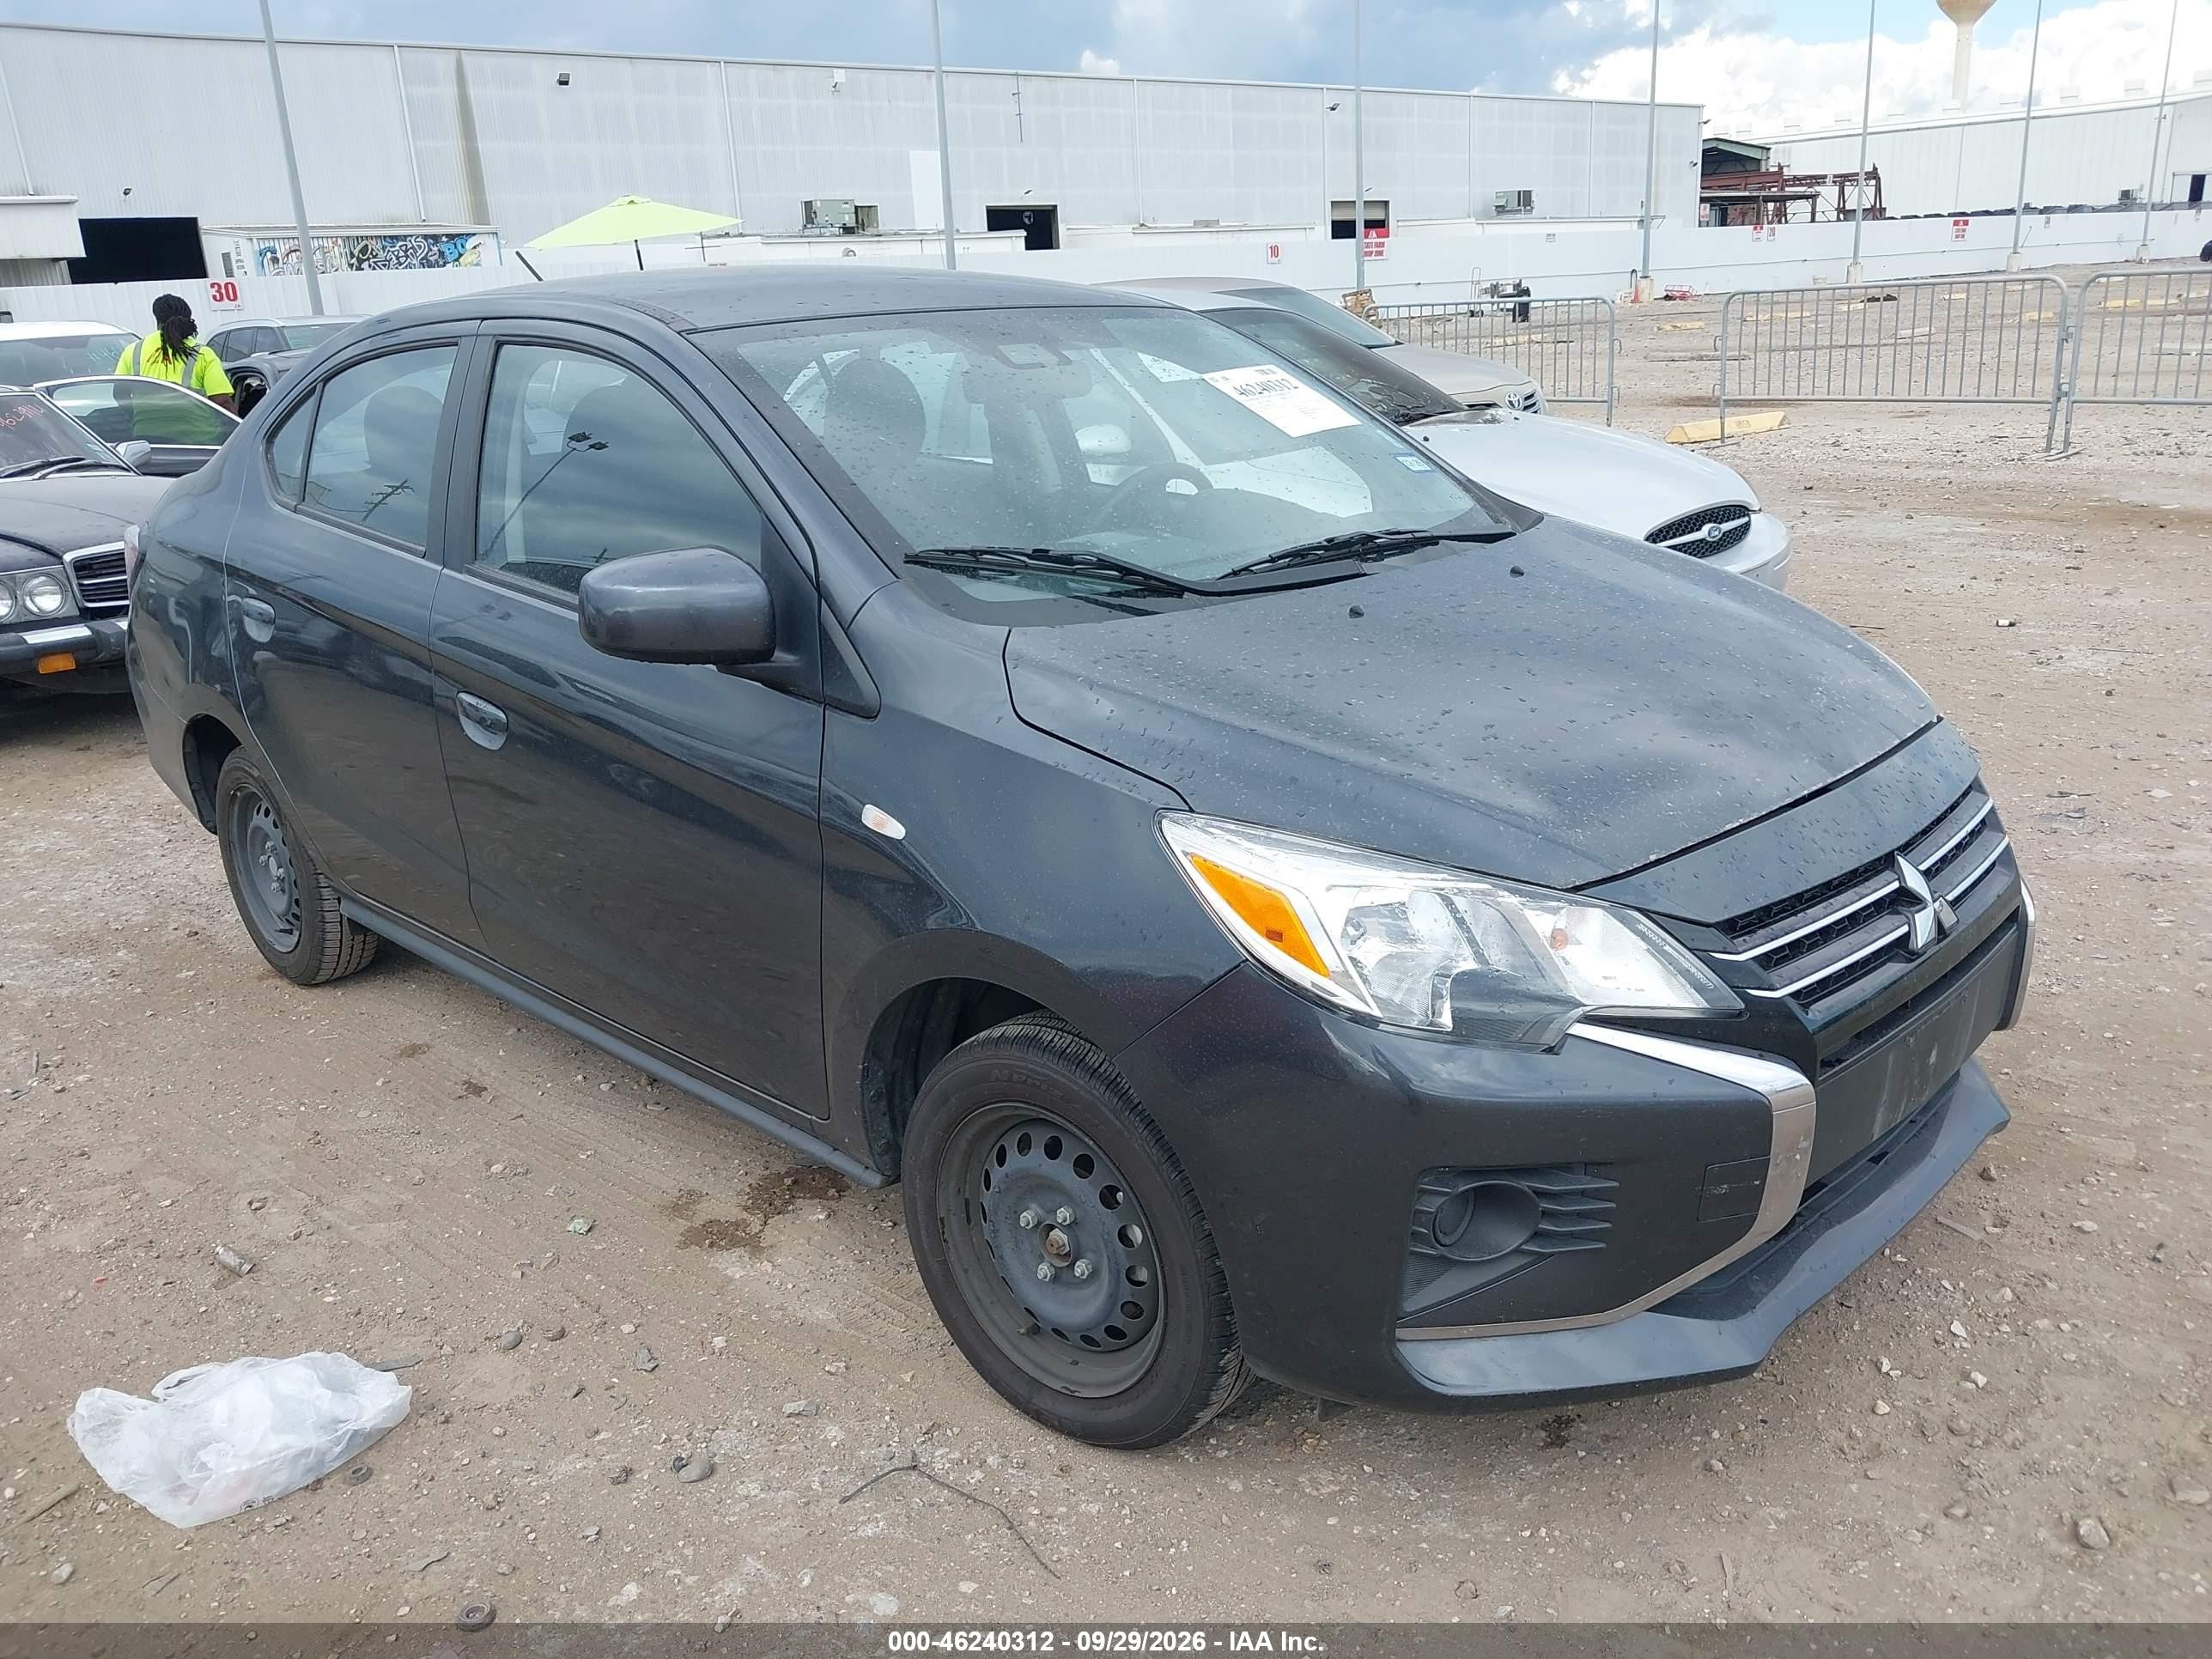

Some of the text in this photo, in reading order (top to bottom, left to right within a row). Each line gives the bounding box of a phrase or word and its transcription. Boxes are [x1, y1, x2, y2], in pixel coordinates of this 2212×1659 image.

[1268, 244, 1279, 258] 10
[210, 281, 238, 302] 30
[1231, 378, 1299, 398] 46240312
